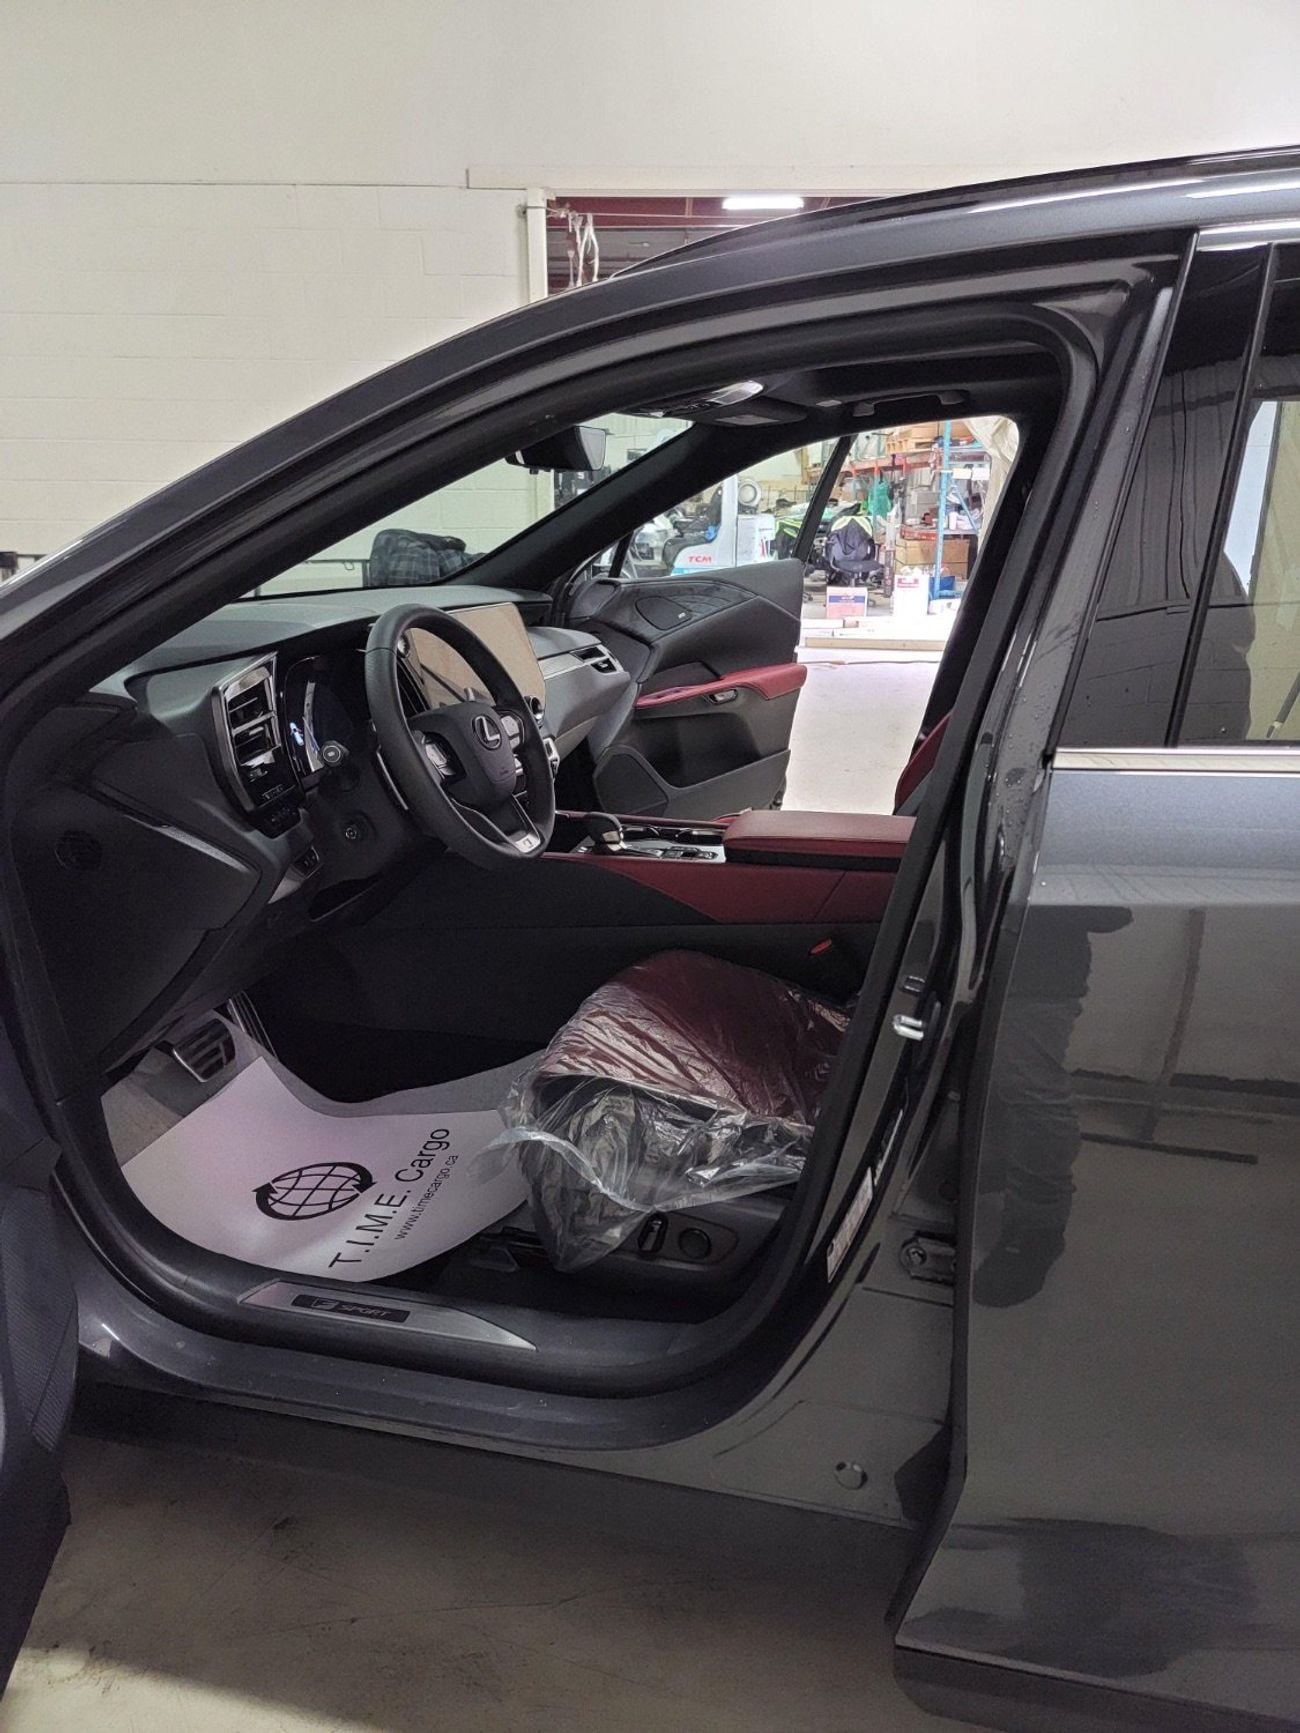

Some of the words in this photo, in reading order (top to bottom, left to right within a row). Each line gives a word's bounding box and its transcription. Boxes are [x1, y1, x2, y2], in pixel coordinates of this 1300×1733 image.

[688, 555, 712, 563] TCM
[328, 1190, 412, 1268] T.I.M.E.
[395, 1128, 450, 1182] Cargo
[394, 1155, 459, 1240] www.timecargo.ca
